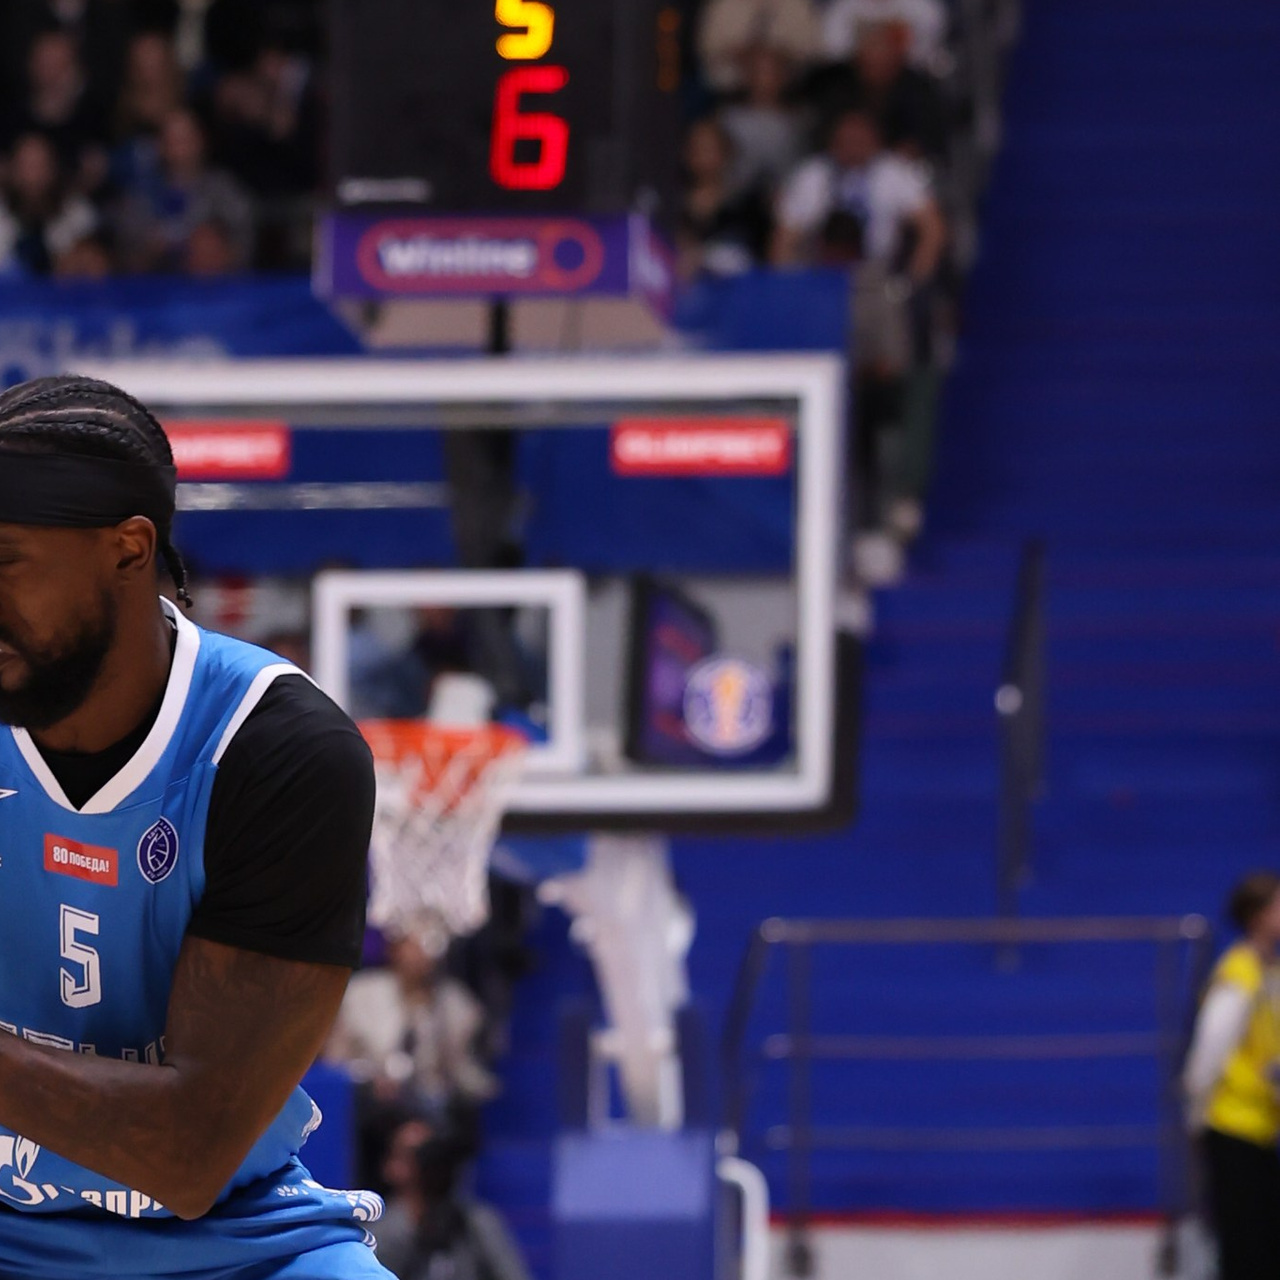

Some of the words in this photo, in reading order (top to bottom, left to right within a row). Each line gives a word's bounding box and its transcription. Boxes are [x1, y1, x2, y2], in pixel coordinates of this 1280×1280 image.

[489, 65, 570, 191] 6
[53, 846, 69, 865] 80
[69, 852, 110, 873] ПОБЕДА!
[60, 904, 101, 1008] 5
